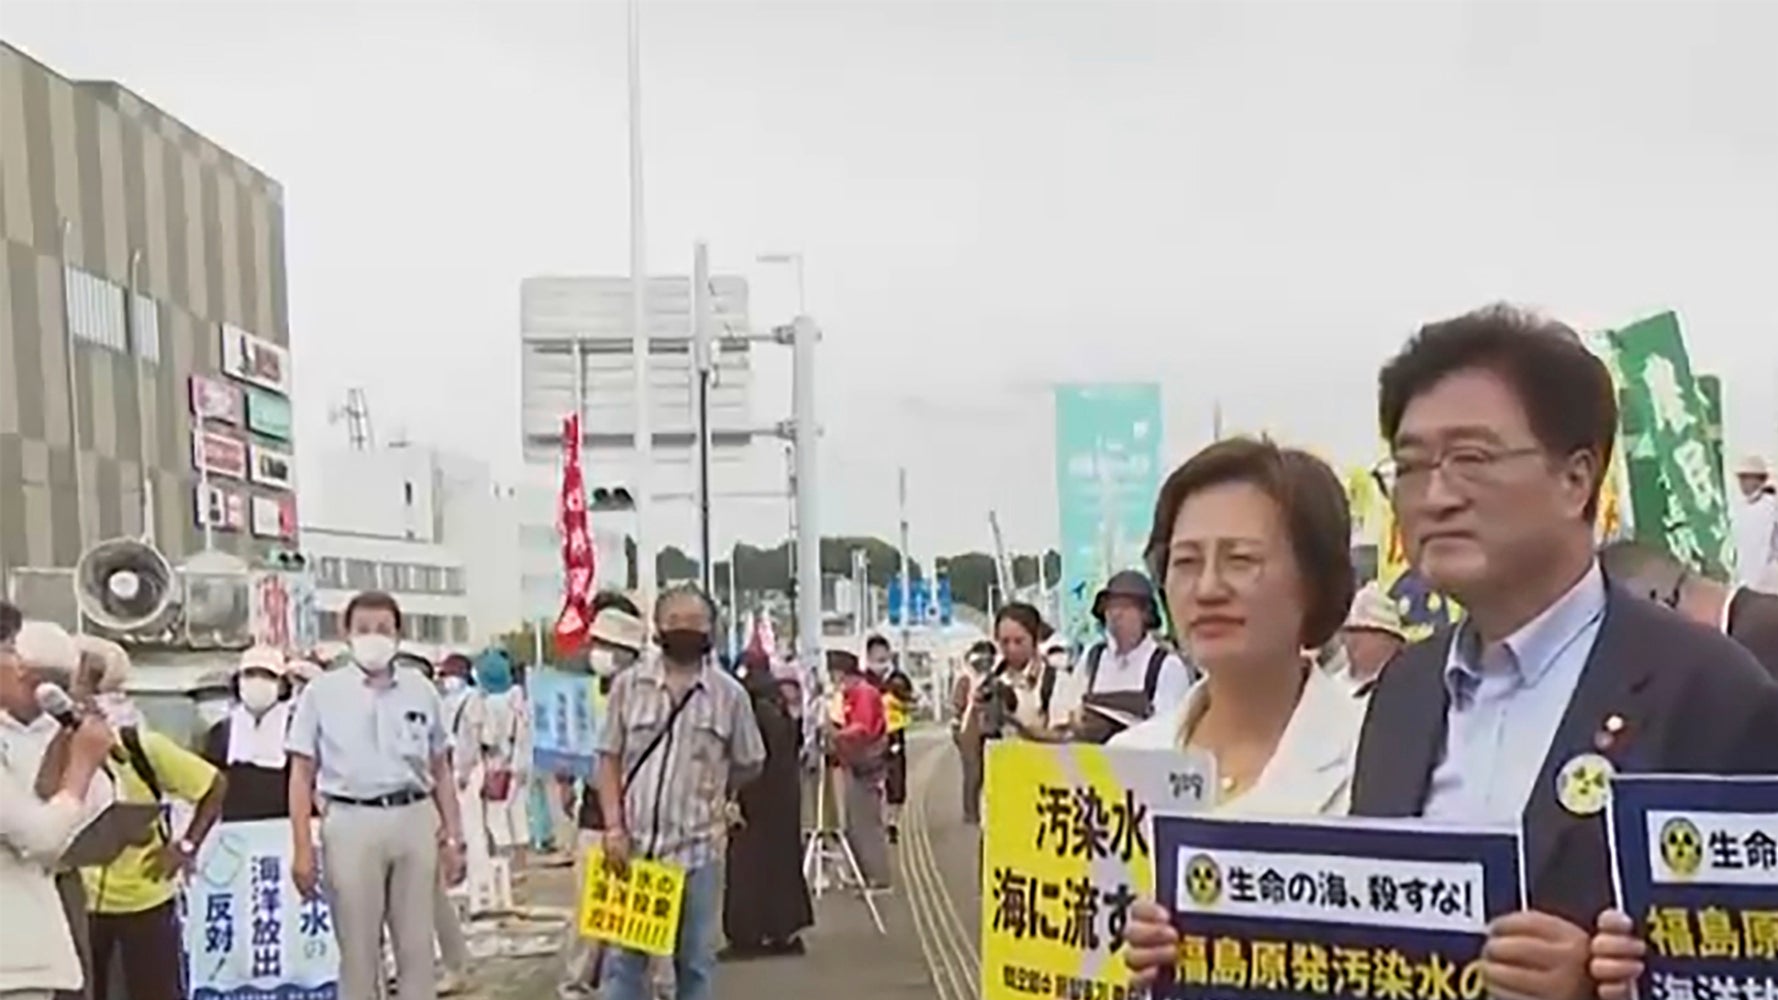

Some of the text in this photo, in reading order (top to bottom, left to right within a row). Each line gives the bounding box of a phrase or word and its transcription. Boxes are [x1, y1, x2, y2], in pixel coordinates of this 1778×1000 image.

[1036, 784, 1149, 863] 汚染水
[993, 867, 1137, 954] 海に流す
[1228, 866, 1472, 918] 生命の海、殺すな!
